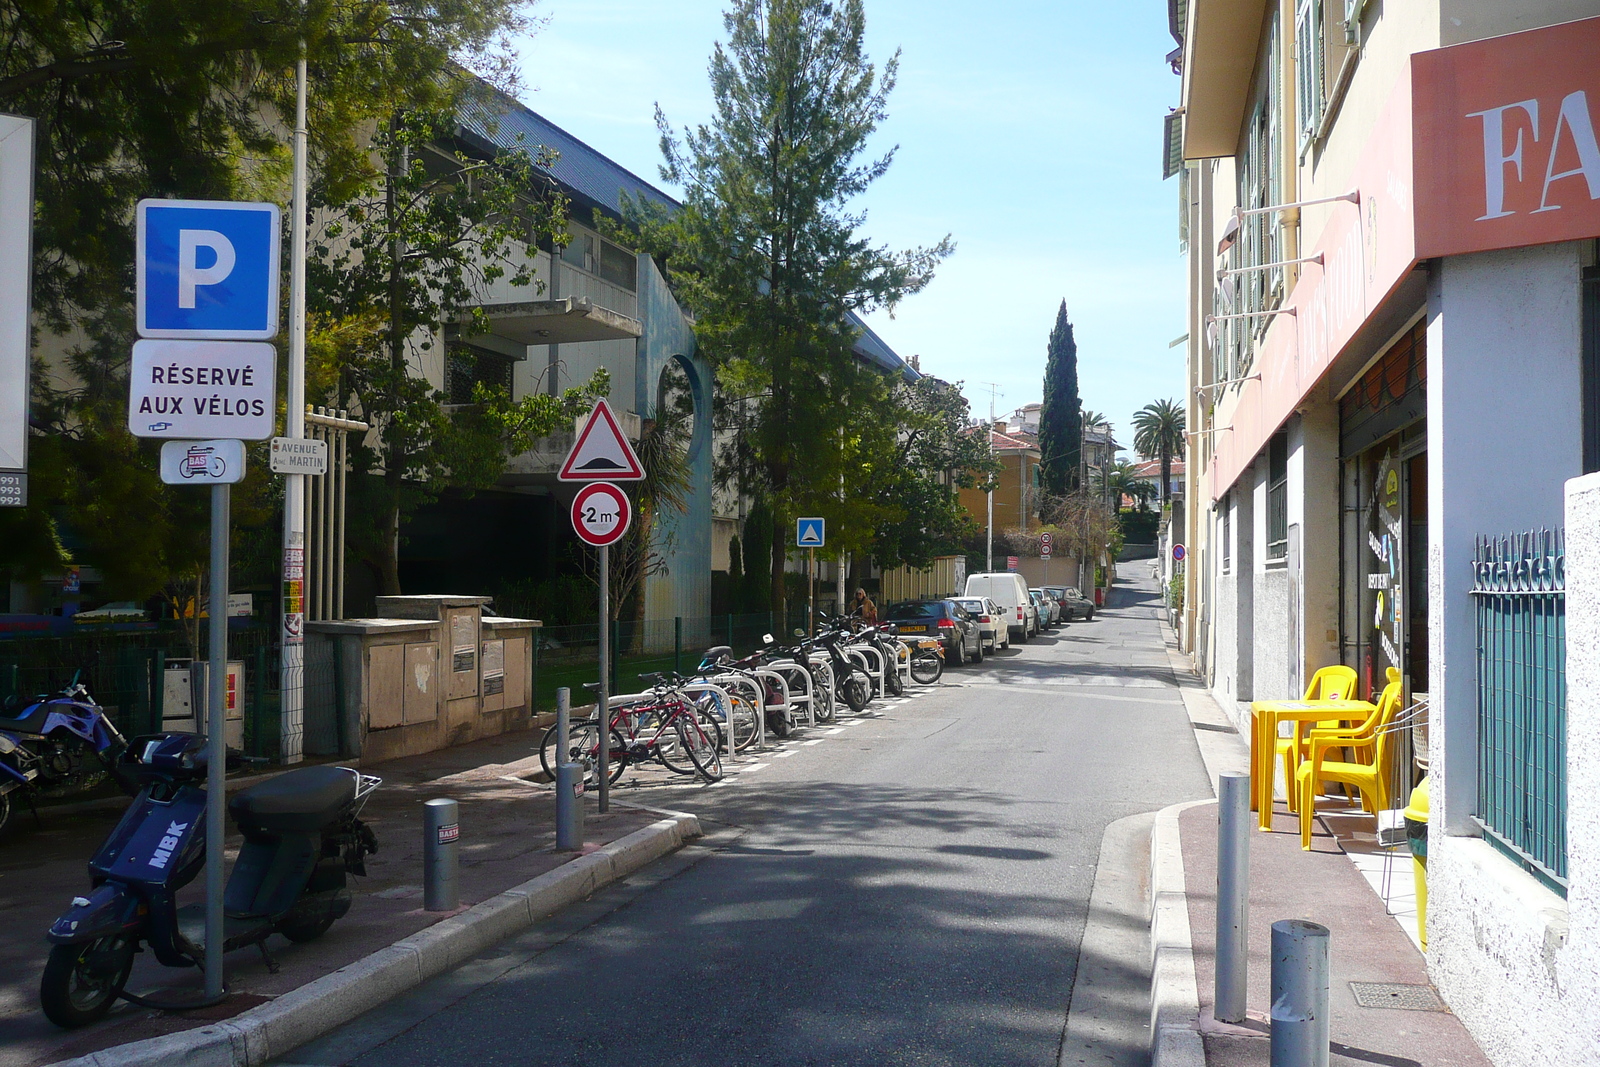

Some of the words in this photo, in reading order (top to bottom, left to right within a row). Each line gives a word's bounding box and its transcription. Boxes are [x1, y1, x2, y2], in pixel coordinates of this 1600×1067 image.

[179, 229, 236, 309] P
[1329, 219, 1362, 342] FOOD
[152, 363, 254, 386] RÉSERVÉ
[139, 396, 183, 415] AUX
[194, 394, 265, 417] VÉLOS
[281, 443, 318, 455] AVENUE
[289, 456, 324, 468] MARTIN
[0, 476, 20, 485] 991
[0, 486, 21, 495] 993
[0, 496, 21, 505] 992
[586, 506, 597, 523] 2
[600, 512, 612, 523] m
[148, 820, 188, 869] MBK
